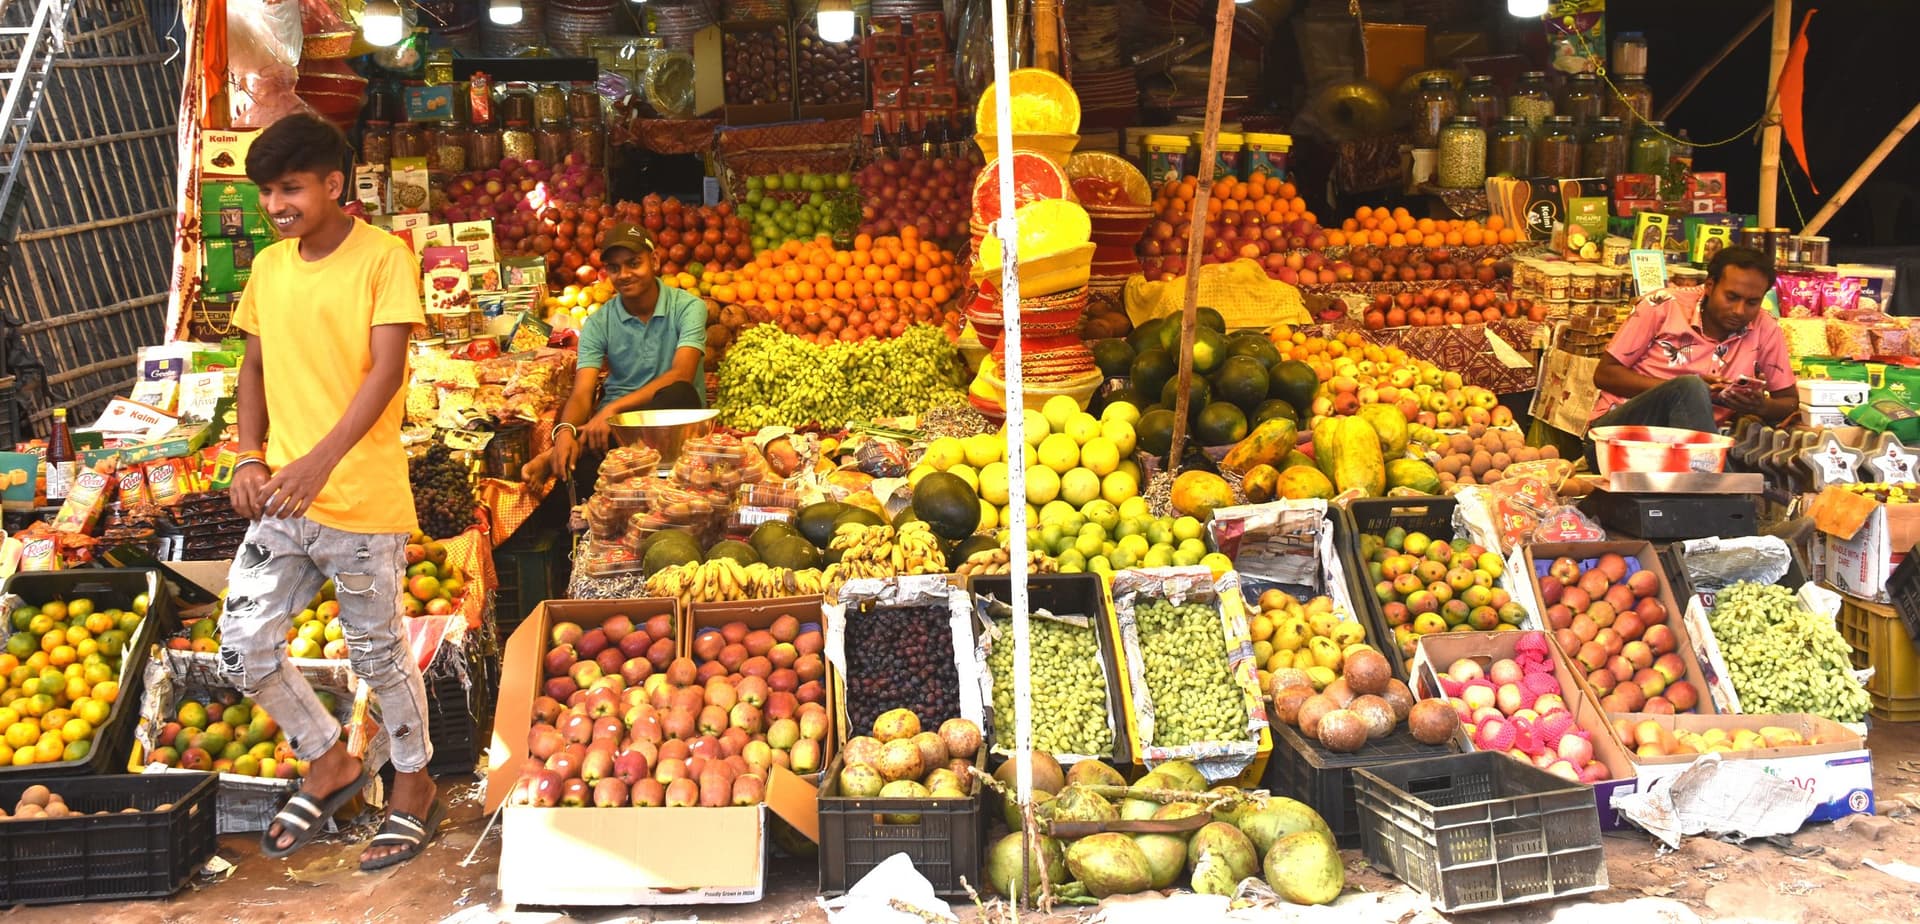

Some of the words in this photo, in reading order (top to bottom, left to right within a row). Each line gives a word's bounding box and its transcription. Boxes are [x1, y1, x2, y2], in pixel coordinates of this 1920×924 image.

[209, 135, 238, 143] Kalmi
[151, 368, 177, 379] Geeta
[130, 410, 160, 425] Kalmi
[83, 474, 104, 486] Real
[152, 464, 173, 482] Real
[123, 471, 142, 491] Real
[28, 540, 54, 556] Real
